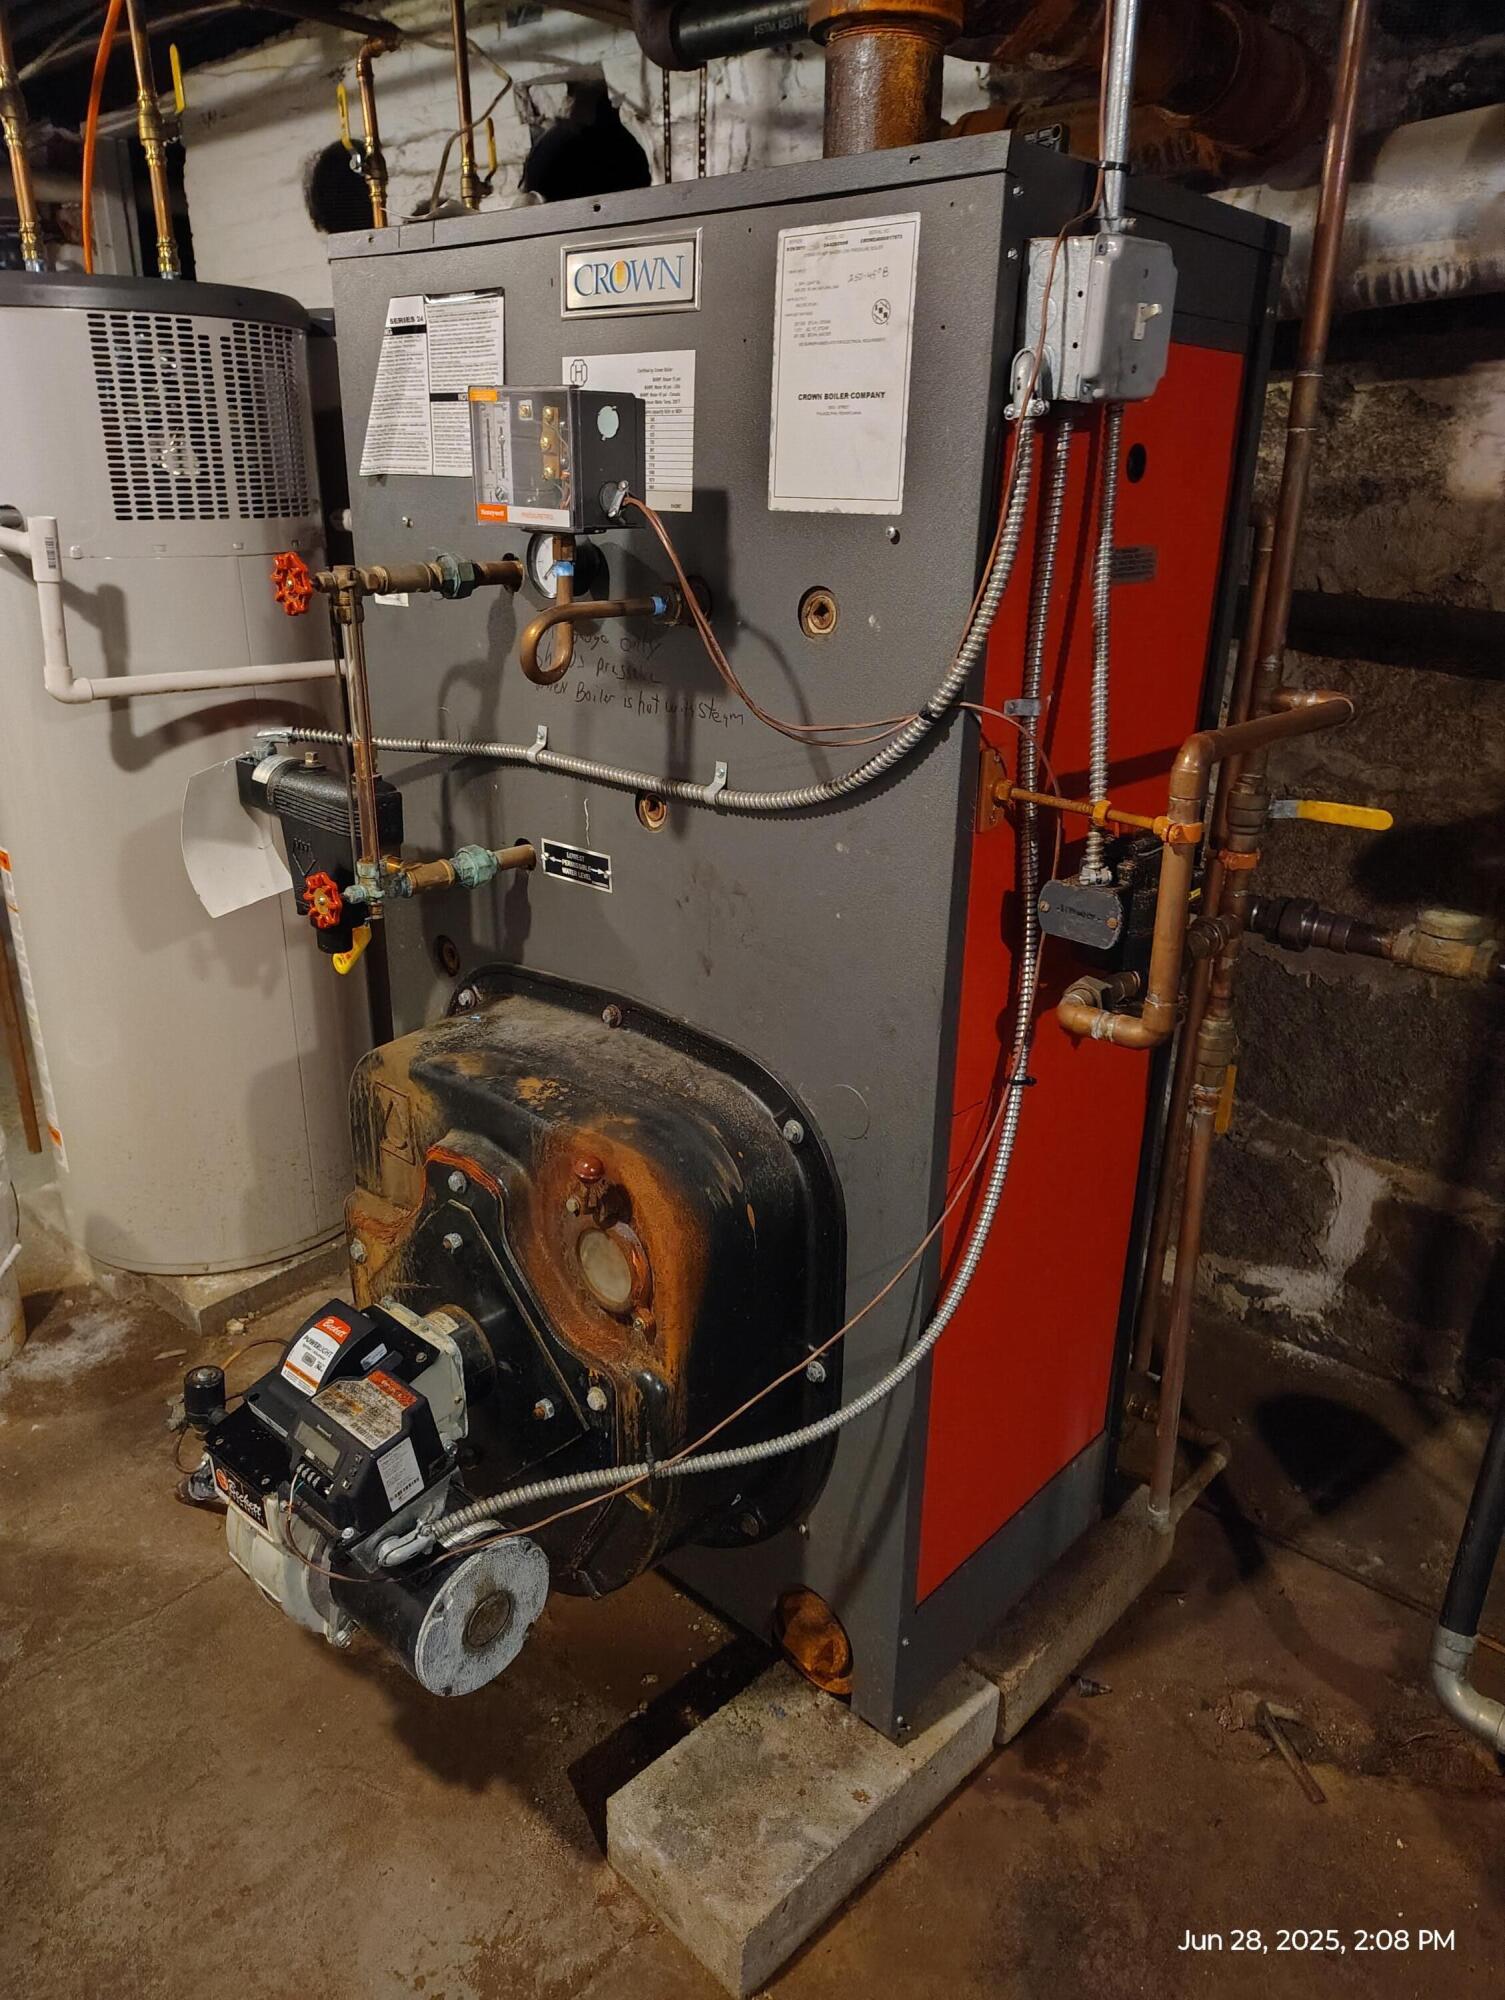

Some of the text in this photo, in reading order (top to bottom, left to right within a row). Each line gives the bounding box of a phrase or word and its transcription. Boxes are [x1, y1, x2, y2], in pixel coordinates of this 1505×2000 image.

[574, 255, 684, 297] CROWN
[389, 316, 415, 325] SERIES
[798, 391, 886, 401] CROWN BOILER COMPANY
[561, 866, 592, 881] WATER LEVEL
[228, 1478, 262, 1517] Beckett
